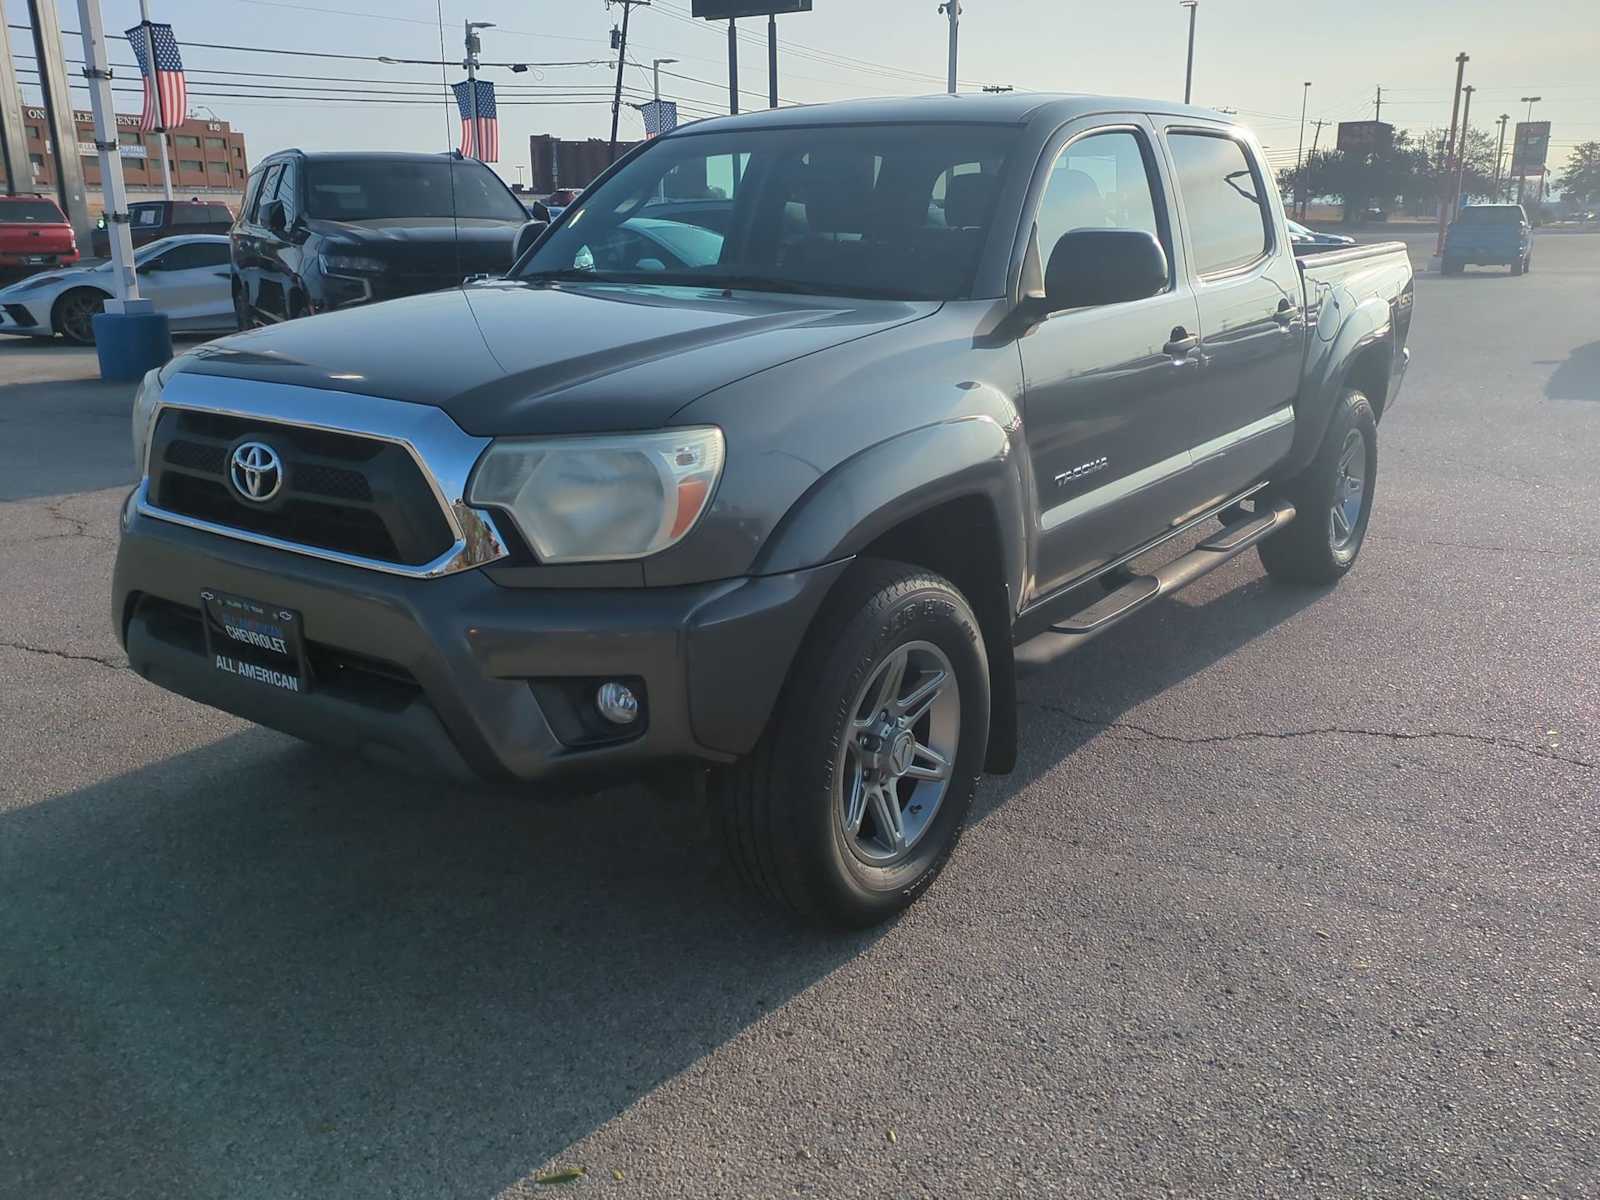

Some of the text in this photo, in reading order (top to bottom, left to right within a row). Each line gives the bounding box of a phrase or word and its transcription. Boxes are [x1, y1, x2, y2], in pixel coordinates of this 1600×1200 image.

[1054, 456, 1107, 487] TACOMA
[225, 624, 287, 654] CHEVROLET
[216, 654, 298, 691] ALL AMERICAN
